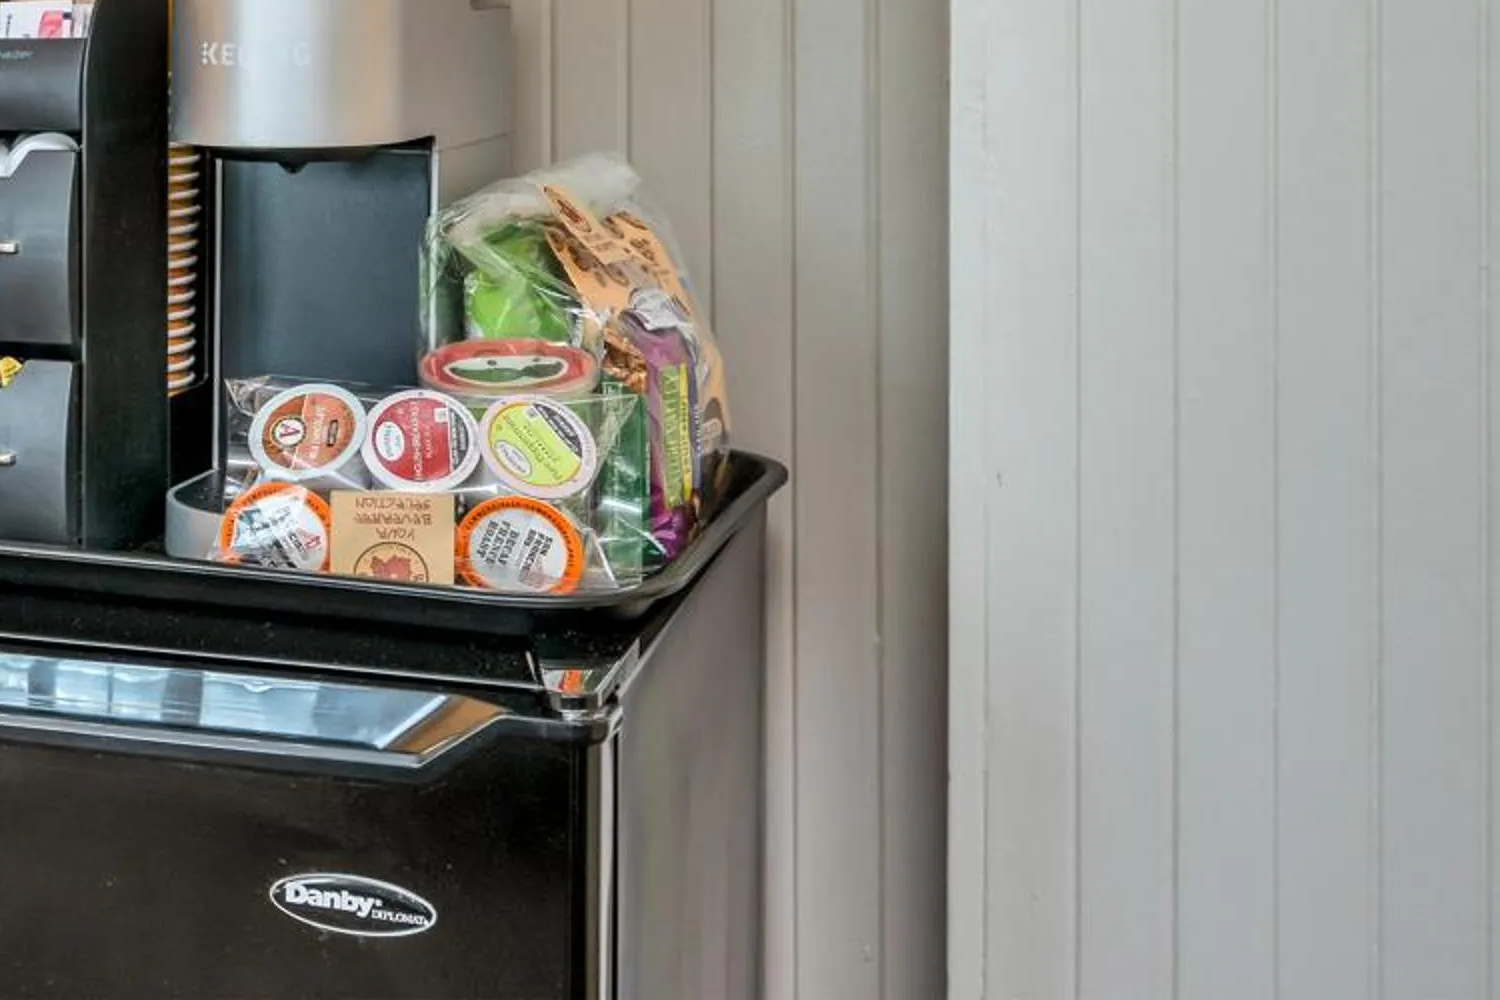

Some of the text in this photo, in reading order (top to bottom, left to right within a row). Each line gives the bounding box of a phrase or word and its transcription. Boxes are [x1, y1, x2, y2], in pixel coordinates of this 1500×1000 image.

[199, 40, 313, 67] KEUG
[375, 527, 415, 541] YOUR
[476, 520, 499, 558] ROAST
[484, 520, 511, 566] FRENCH
[497, 529, 521, 566] DECAF
[283, 880, 375, 918] Danby
